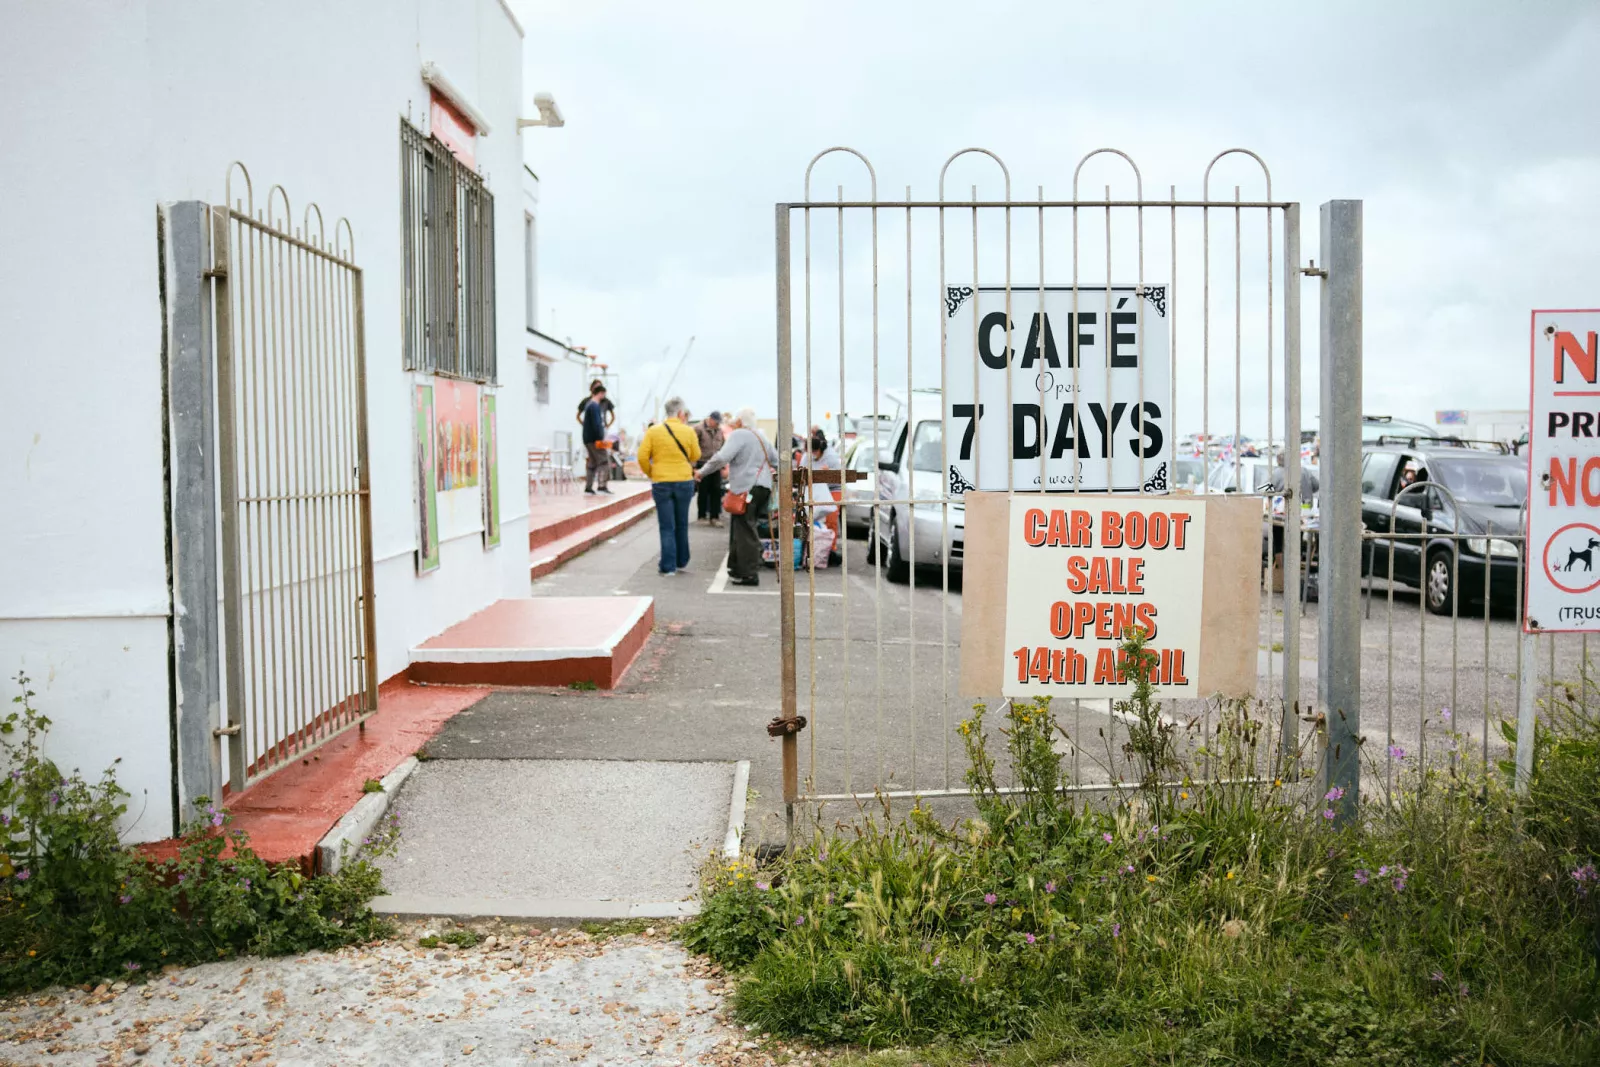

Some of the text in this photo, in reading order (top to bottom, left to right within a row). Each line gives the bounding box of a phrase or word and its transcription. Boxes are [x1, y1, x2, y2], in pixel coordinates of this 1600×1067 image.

[978, 297, 1138, 370] CAFÉ
[1553, 331, 1598, 384] N
[1035, 371, 1081, 400] Open
[952, 401, 1163, 460] 7 DAYS
[1033, 475, 1043, 485] a
[1024, 508, 1191, 550] CAR BOOT
[1066, 555, 1145, 595] SALE
[1050, 601, 1157, 640] OPENS
[1013, 646, 1087, 685] 14th
